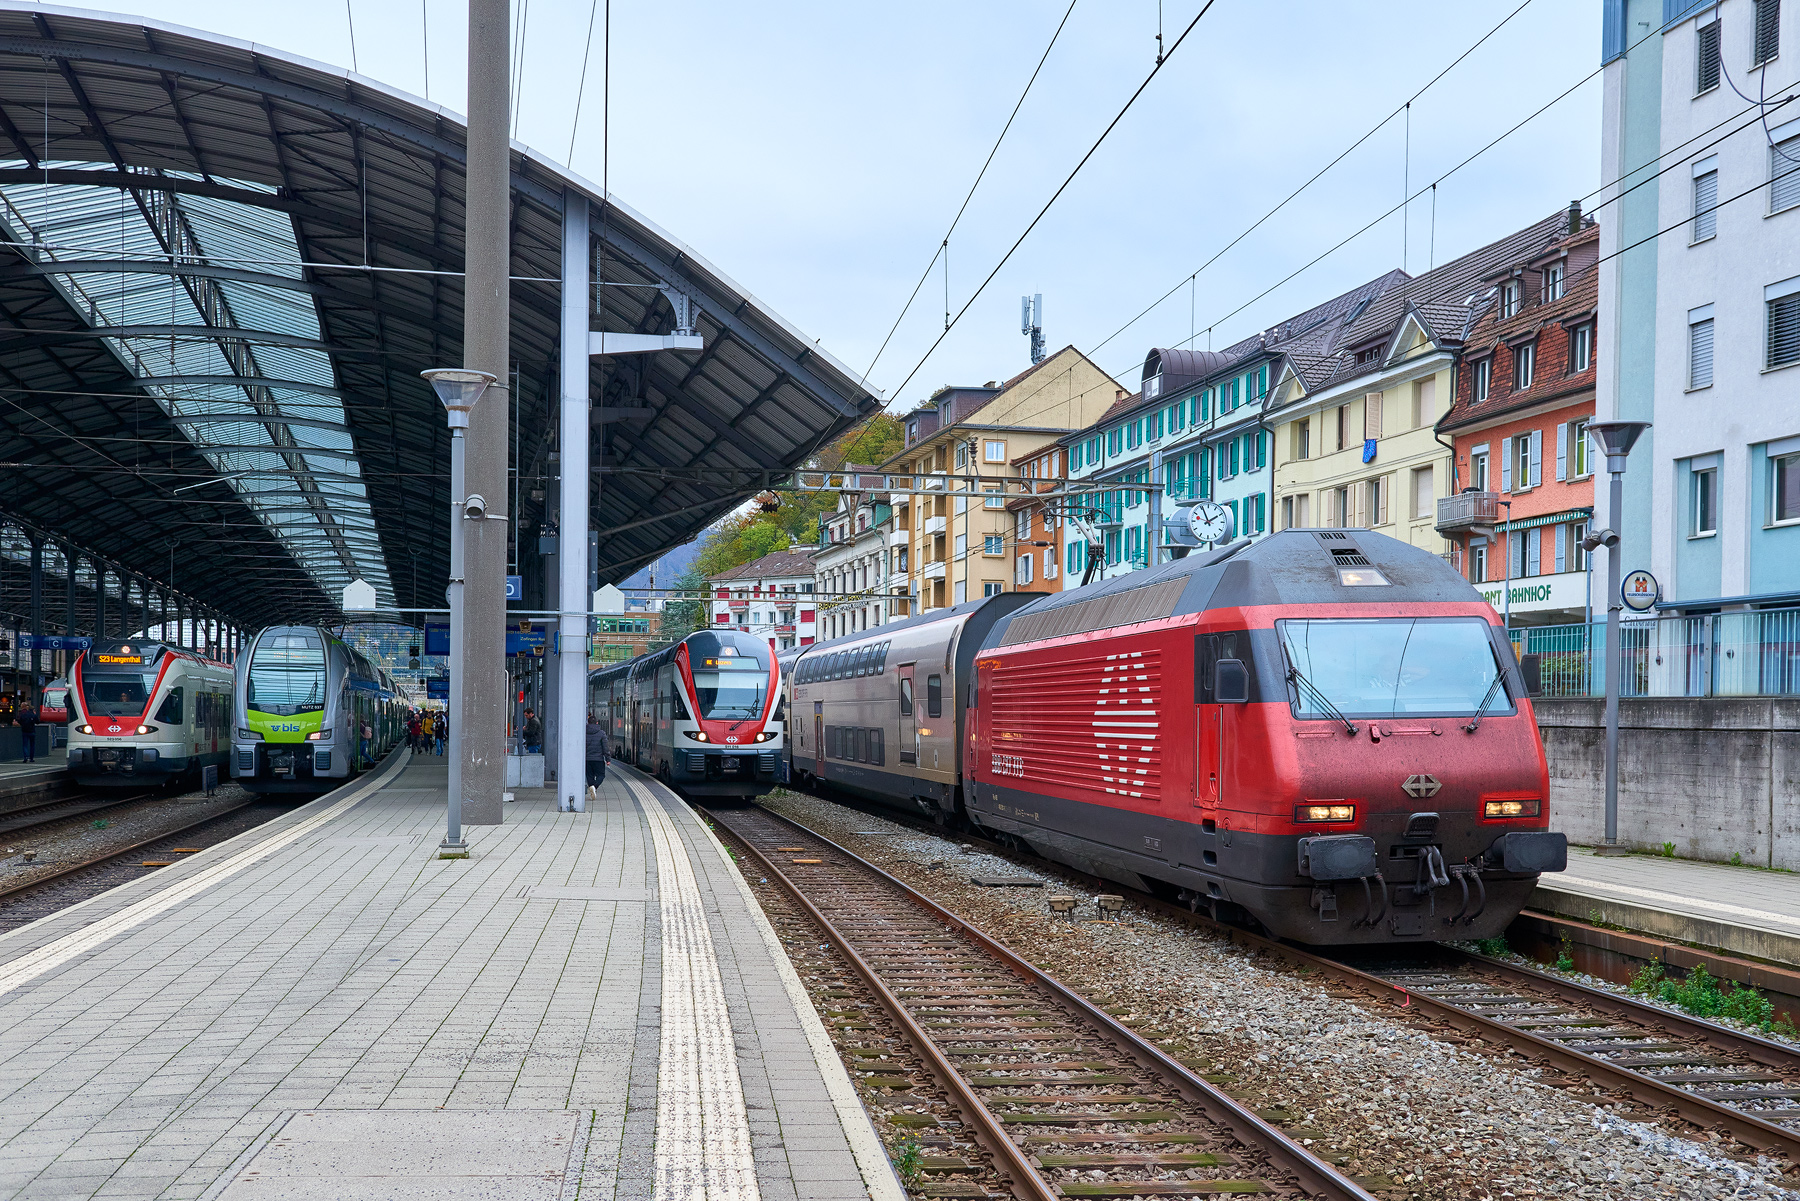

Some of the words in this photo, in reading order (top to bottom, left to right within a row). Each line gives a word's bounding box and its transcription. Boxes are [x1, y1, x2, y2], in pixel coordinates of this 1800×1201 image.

[1481, 590, 1502, 605] ANT
[1508, 584, 1551, 603] BAHNHOF
[110, 656, 141, 664] Langenthal
[282, 723, 300, 732] bls
